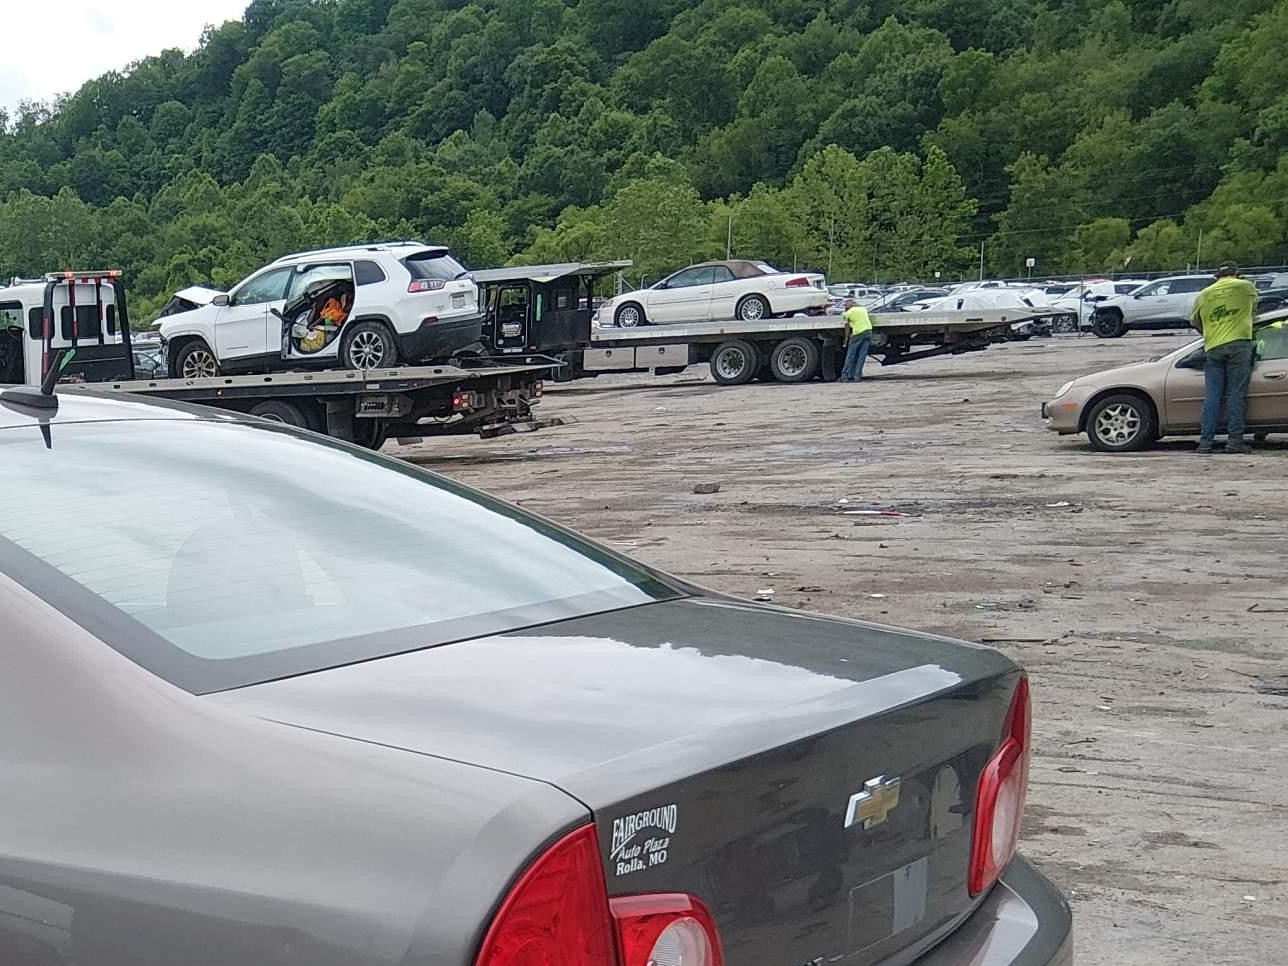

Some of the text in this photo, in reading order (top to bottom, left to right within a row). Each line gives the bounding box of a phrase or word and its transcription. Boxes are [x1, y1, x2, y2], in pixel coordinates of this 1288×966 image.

[611, 804, 677, 853] FAIRGROUND
[616, 837, 670, 862] Auto Plaza
[616, 850, 667, 876] Rolla, MO
